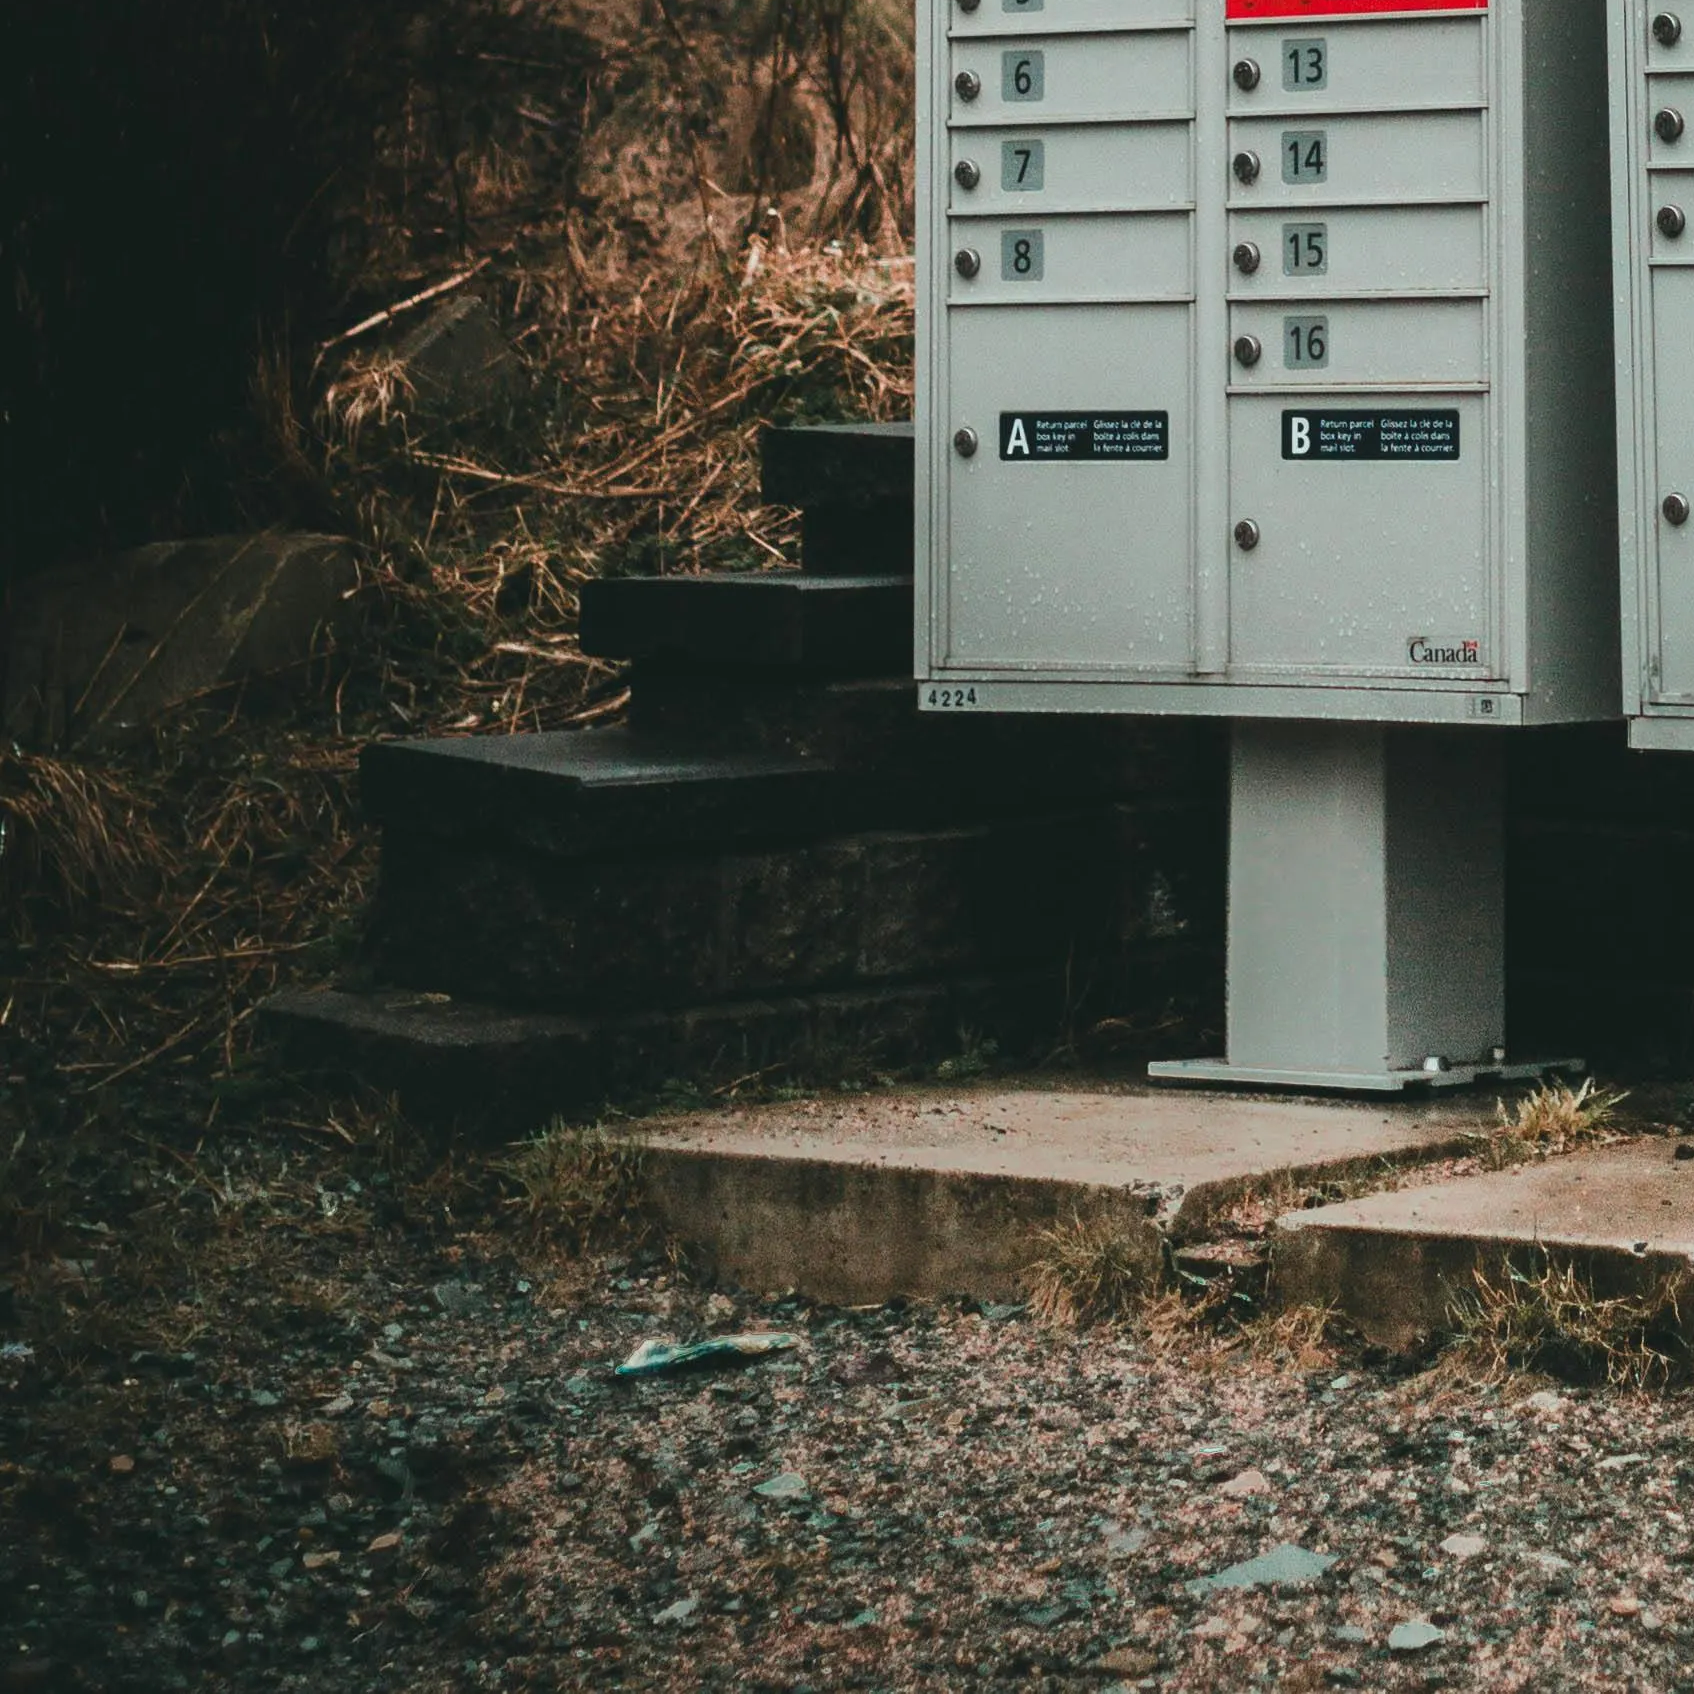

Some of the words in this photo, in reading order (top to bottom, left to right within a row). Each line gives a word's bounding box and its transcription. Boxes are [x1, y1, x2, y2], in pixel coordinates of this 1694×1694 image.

[1014, 59, 1032, 95] 6
[1288, 47, 1323, 84] 13
[1014, 148, 1032, 184] 7
[1288, 139, 1324, 176] 14
[1013, 238, 1032, 274] 8
[1288, 231, 1323, 268] 15
[1290, 324, 1326, 361] 16
[1006, 418, 1030, 455] A
[1291, 416, 1311, 455] B
[1409, 640, 1478, 663] Canada
[928, 687, 977, 708] 4224
